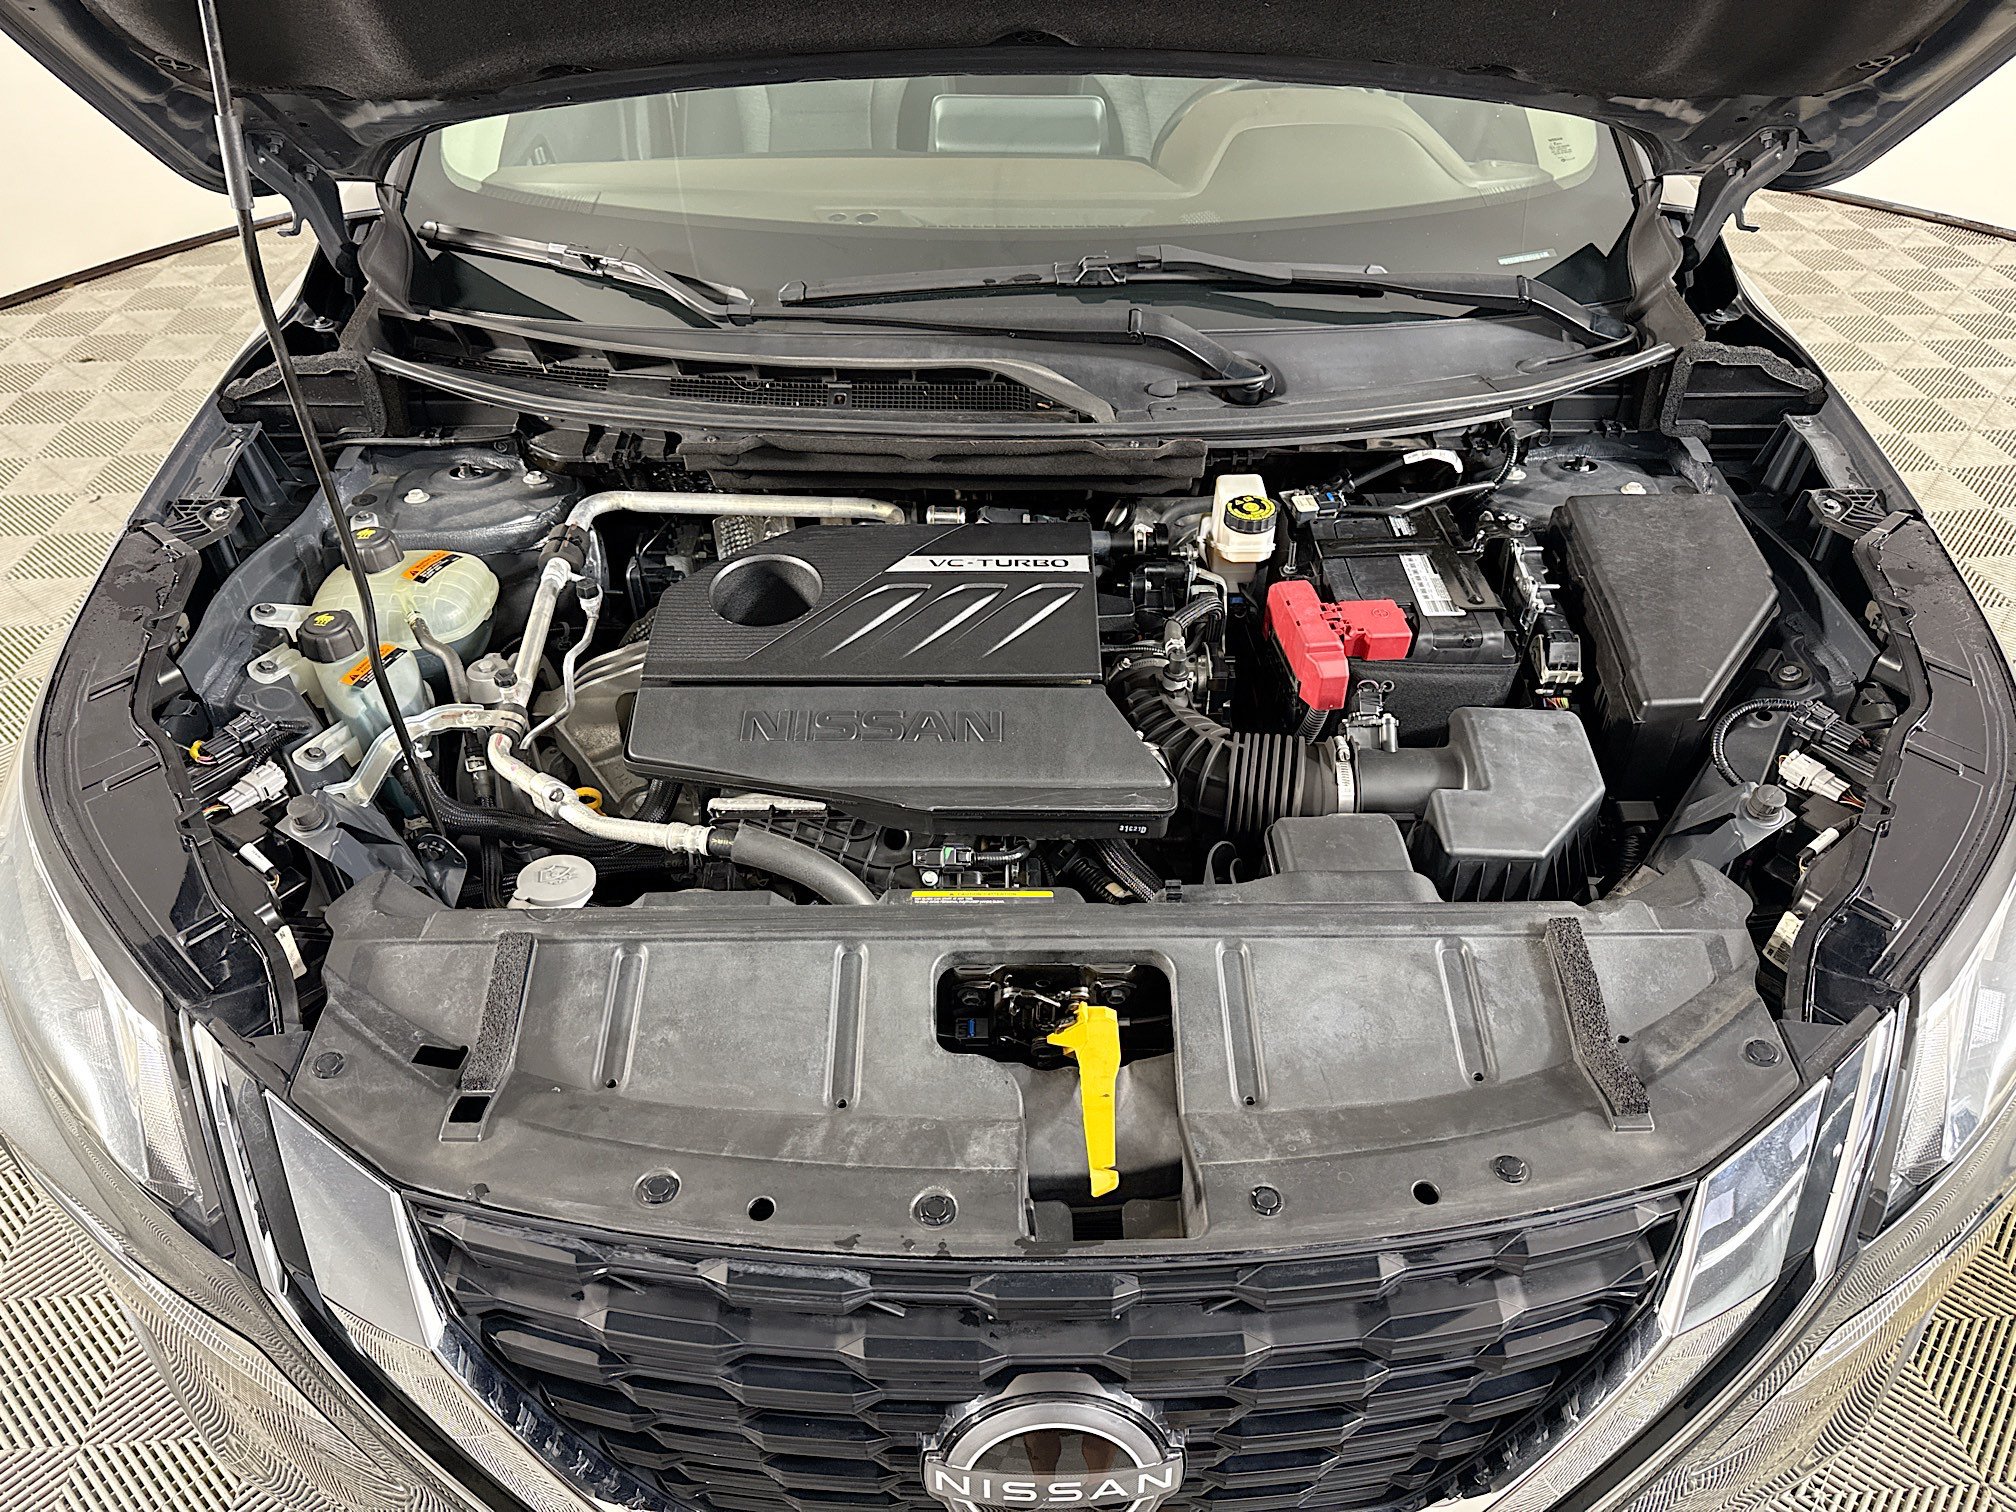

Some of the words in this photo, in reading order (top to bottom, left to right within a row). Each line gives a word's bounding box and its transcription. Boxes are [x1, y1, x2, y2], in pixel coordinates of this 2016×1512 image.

[929, 559, 1069, 567] VC-TURBO
[739, 709, 1003, 742] NISSAN
[935, 1467, 1173, 1502] NISSAN
